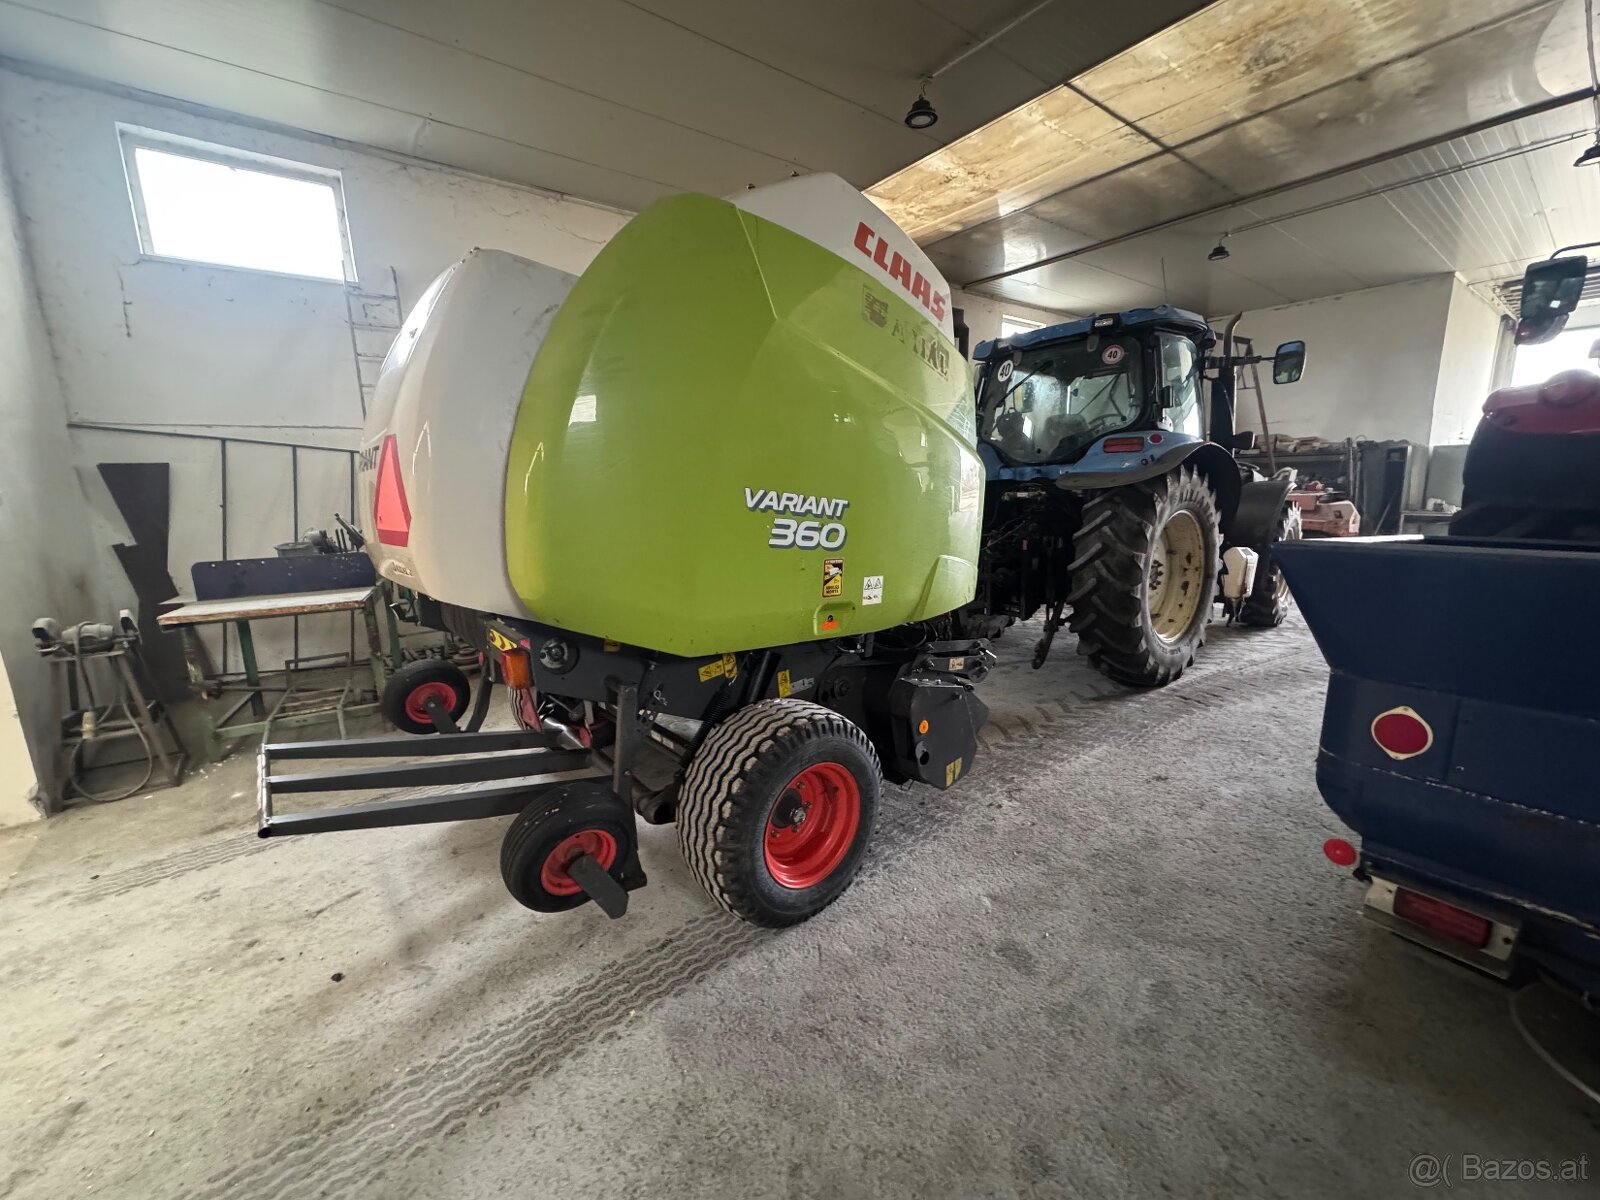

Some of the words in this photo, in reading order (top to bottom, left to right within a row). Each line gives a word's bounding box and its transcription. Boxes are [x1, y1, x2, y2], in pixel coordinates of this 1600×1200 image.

[853, 221, 946, 322] CLAAS
[999, 363, 1011, 379] 40
[1107, 350, 1118, 360] 40
[744, 487, 850, 520] VARIANT
[768, 517, 848, 551] 360
